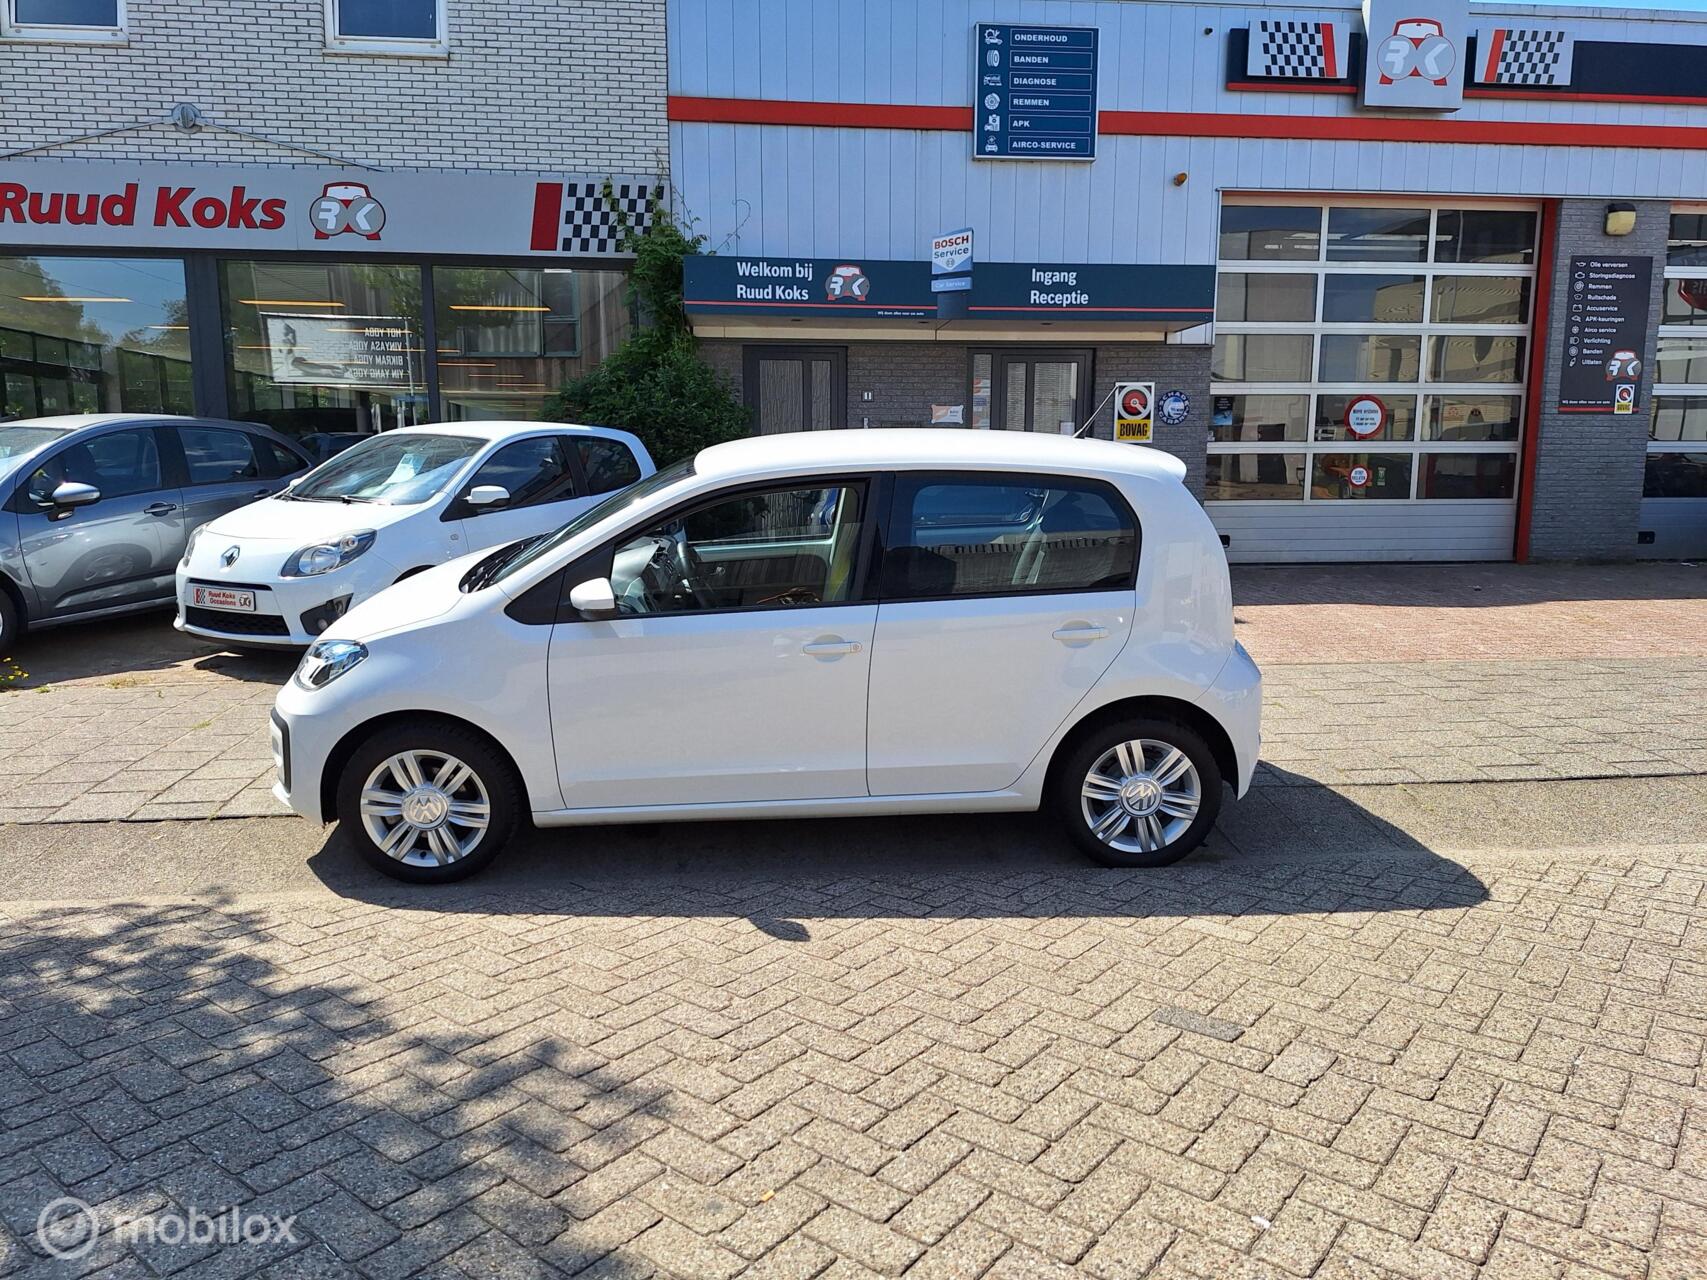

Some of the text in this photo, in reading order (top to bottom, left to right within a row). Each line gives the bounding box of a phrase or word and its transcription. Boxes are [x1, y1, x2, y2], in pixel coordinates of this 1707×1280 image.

[1014, 34, 1068, 42] ONDERHOUD
[1014, 55, 1049, 64] BANDEN
[1013, 78, 1057, 86] DIAGNOSE
[1012, 98, 1050, 106] REMMEN
[1012, 142, 1076, 150] AIRCO-SERVICE
[0, 182, 287, 230] Ruud Koks
[934, 234, 969, 250] BOSCH
[934, 247, 969, 259] Service
[736, 262, 813, 281] Welkom bij
[1032, 268, 1077, 286] Ingang
[736, 286, 809, 301] Ruud Koks
[1030, 290, 1089, 307] Receptie
[1120, 422, 1148, 436] BOVAG
